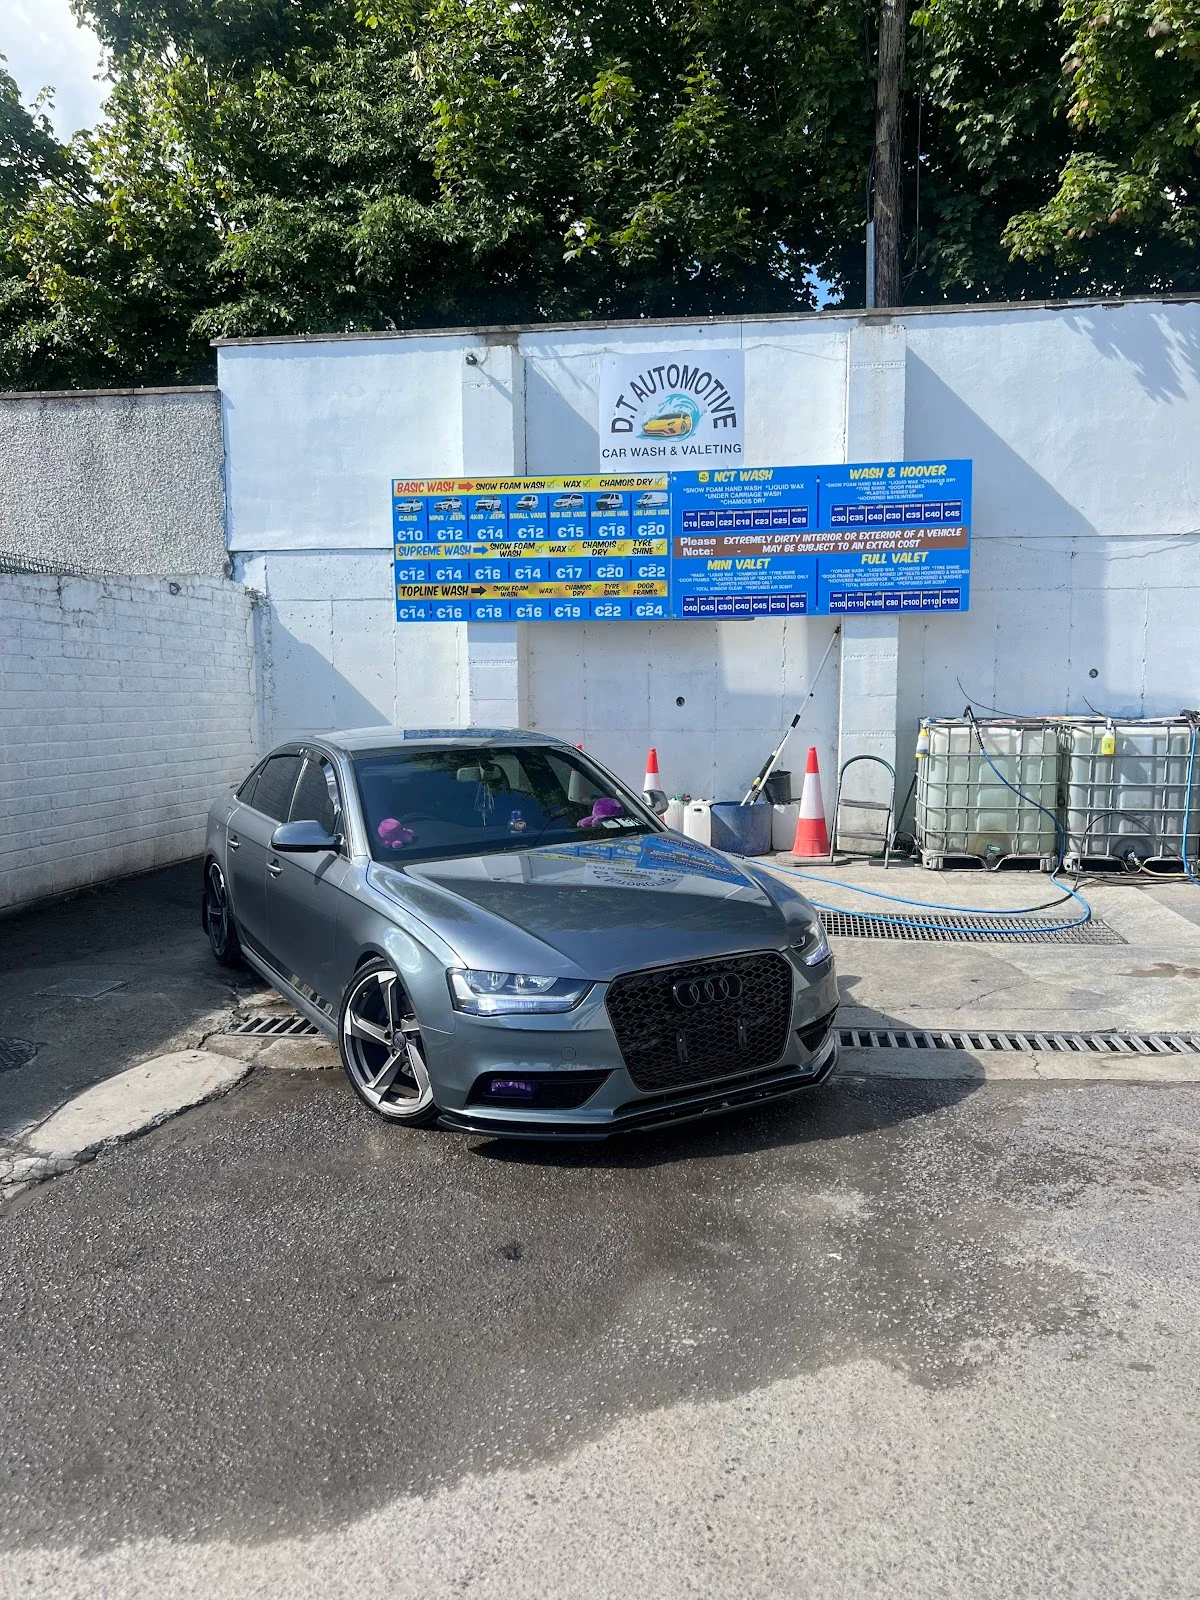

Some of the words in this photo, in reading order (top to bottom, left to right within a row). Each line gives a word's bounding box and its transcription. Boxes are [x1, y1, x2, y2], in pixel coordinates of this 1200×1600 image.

[611, 394, 638, 433] D.T
[630, 364, 736, 429] AUTOMOTIVE
[602, 448, 626, 458] CAR
[630, 446, 666, 457] WASH
[670, 446, 678, 456] &
[682, 444, 741, 455] VALETING
[714, 471, 737, 482] NCT
[740, 470, 773, 481] WASH
[850, 468, 884, 480] WASH
[887, 467, 895, 478] &
[900, 465, 947, 477] HOOVER
[397, 482, 424, 493] BASIC
[427, 481, 454, 492] WASH
[564, 480, 582, 488] WAX
[600, 479, 634, 487] CHAMOIS
[636, 478, 653, 486] DRY
[397, 530, 423, 540] €10
[437, 530, 463, 540] €12
[477, 529, 503, 539] €14
[517, 528, 544, 539] €12
[557, 527, 584, 537] €15
[598, 526, 625, 536] €18
[638, 525, 665, 536] €20
[680, 537, 716, 546] Please
[724, 535, 772, 545] EXTREMELY
[775, 534, 800, 543] DIRTY
[802, 531, 842, 542] INTERIOR
[845, 531, 856, 540] OR
[860, 530, 901, 539] EXTERIOR
[904, 530, 915, 538] OF
[917, 529, 924, 537] A
[927, 528, 962, 537] VEHICLE
[398, 545, 441, 556] SUPREME
[444, 544, 472, 556] WASH
[582, 541, 616, 549] CHAMOIS
[762, 545, 782, 553] MAY
[784, 544, 795, 552] BE
[797, 543, 834, 552] SUBJECT
[837, 542, 849, 550] TO
[851, 542, 864, 550] AN
[866, 540, 895, 549] EXTRA
[898, 540, 921, 548] COST
[683, 548, 714, 556] Note:
[861, 554, 887, 565] FULL
[891, 552, 929, 563] VALET
[707, 560, 732, 570] MINI
[736, 558, 771, 569] VALET
[399, 570, 425, 580] €12
[436, 570, 462, 580] €14
[474, 569, 501, 579] €16
[515, 568, 541, 579] €14
[556, 568, 582, 578] €17
[597, 567, 623, 577] €20
[638, 566, 665, 577] €22
[401, 586, 438, 596] TOPLINE
[442, 586, 469, 596] WASH
[400, 608, 425, 618] €14
[436, 608, 462, 618] €16
[476, 607, 502, 618] €18
[516, 607, 542, 617] €16
[554, 607, 580, 617] €19
[595, 606, 621, 616] €22
[636, 605, 663, 616] €24
